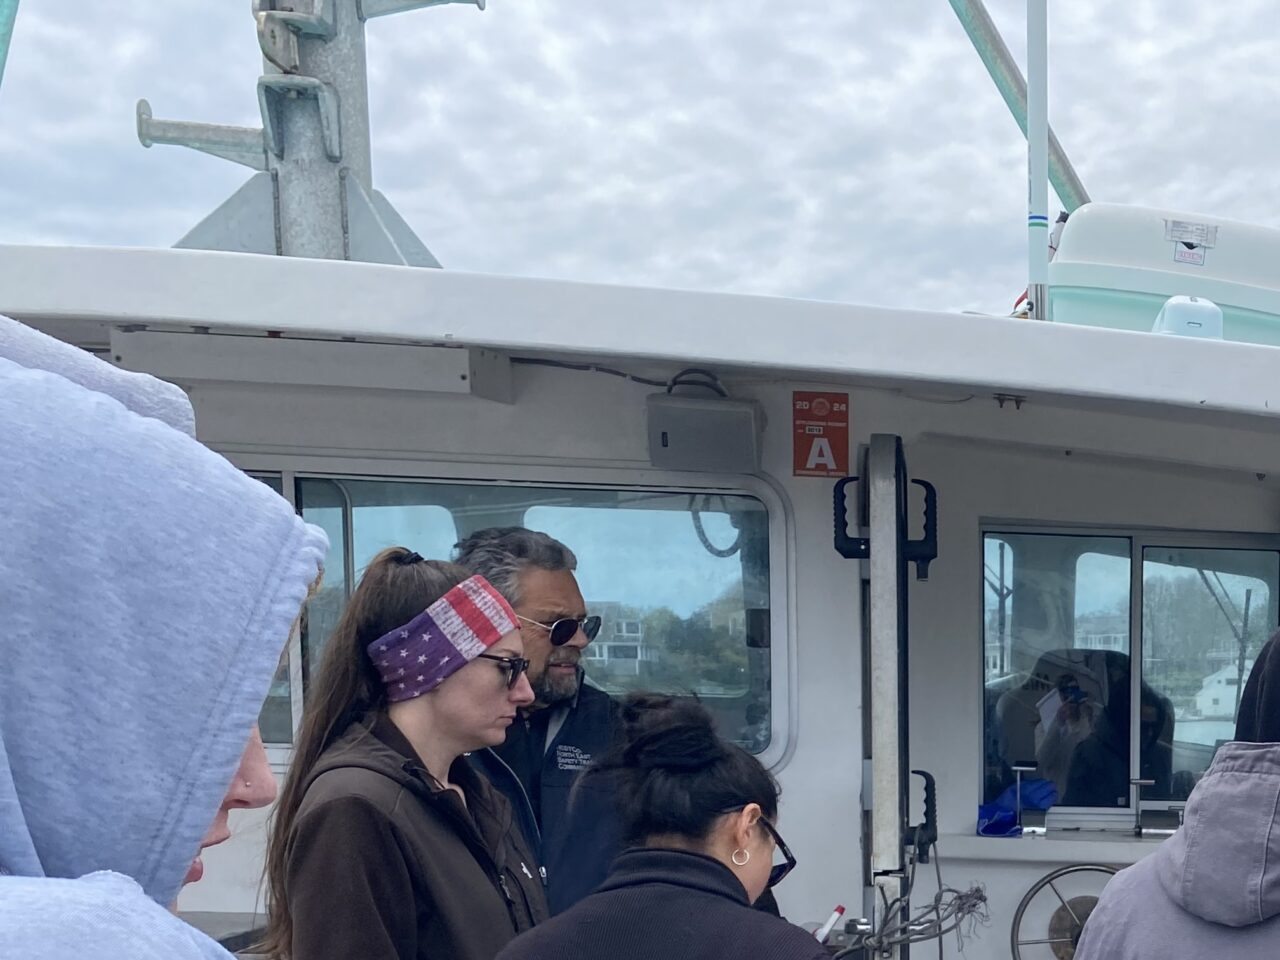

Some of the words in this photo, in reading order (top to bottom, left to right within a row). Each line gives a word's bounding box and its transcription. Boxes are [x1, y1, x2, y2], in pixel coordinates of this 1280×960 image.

[796, 401, 809, 409] 20
[833, 403, 846, 411] 24
[806, 438, 837, 469] A
